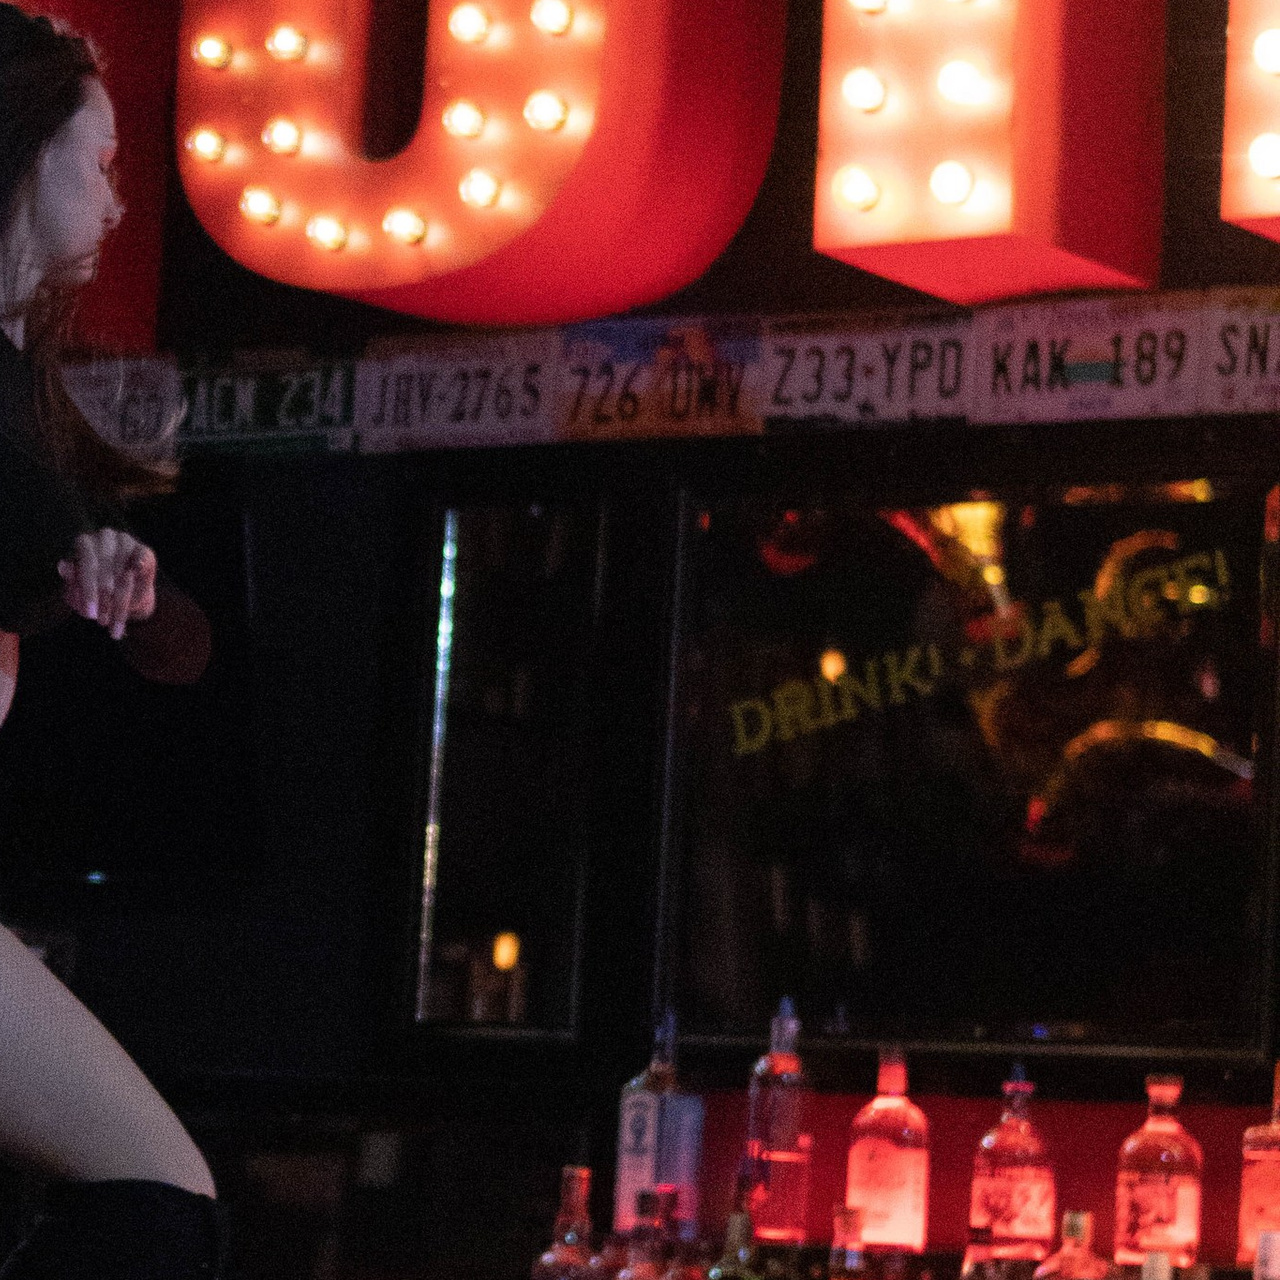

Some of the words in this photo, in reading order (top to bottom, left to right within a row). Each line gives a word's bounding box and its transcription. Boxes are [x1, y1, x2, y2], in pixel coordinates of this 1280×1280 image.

[990, 335, 1071, 396] KAK
[1108, 327, 1188, 388] 189
[1214, 321, 1280, 379] SN
[567, 360, 642, 424] 726
